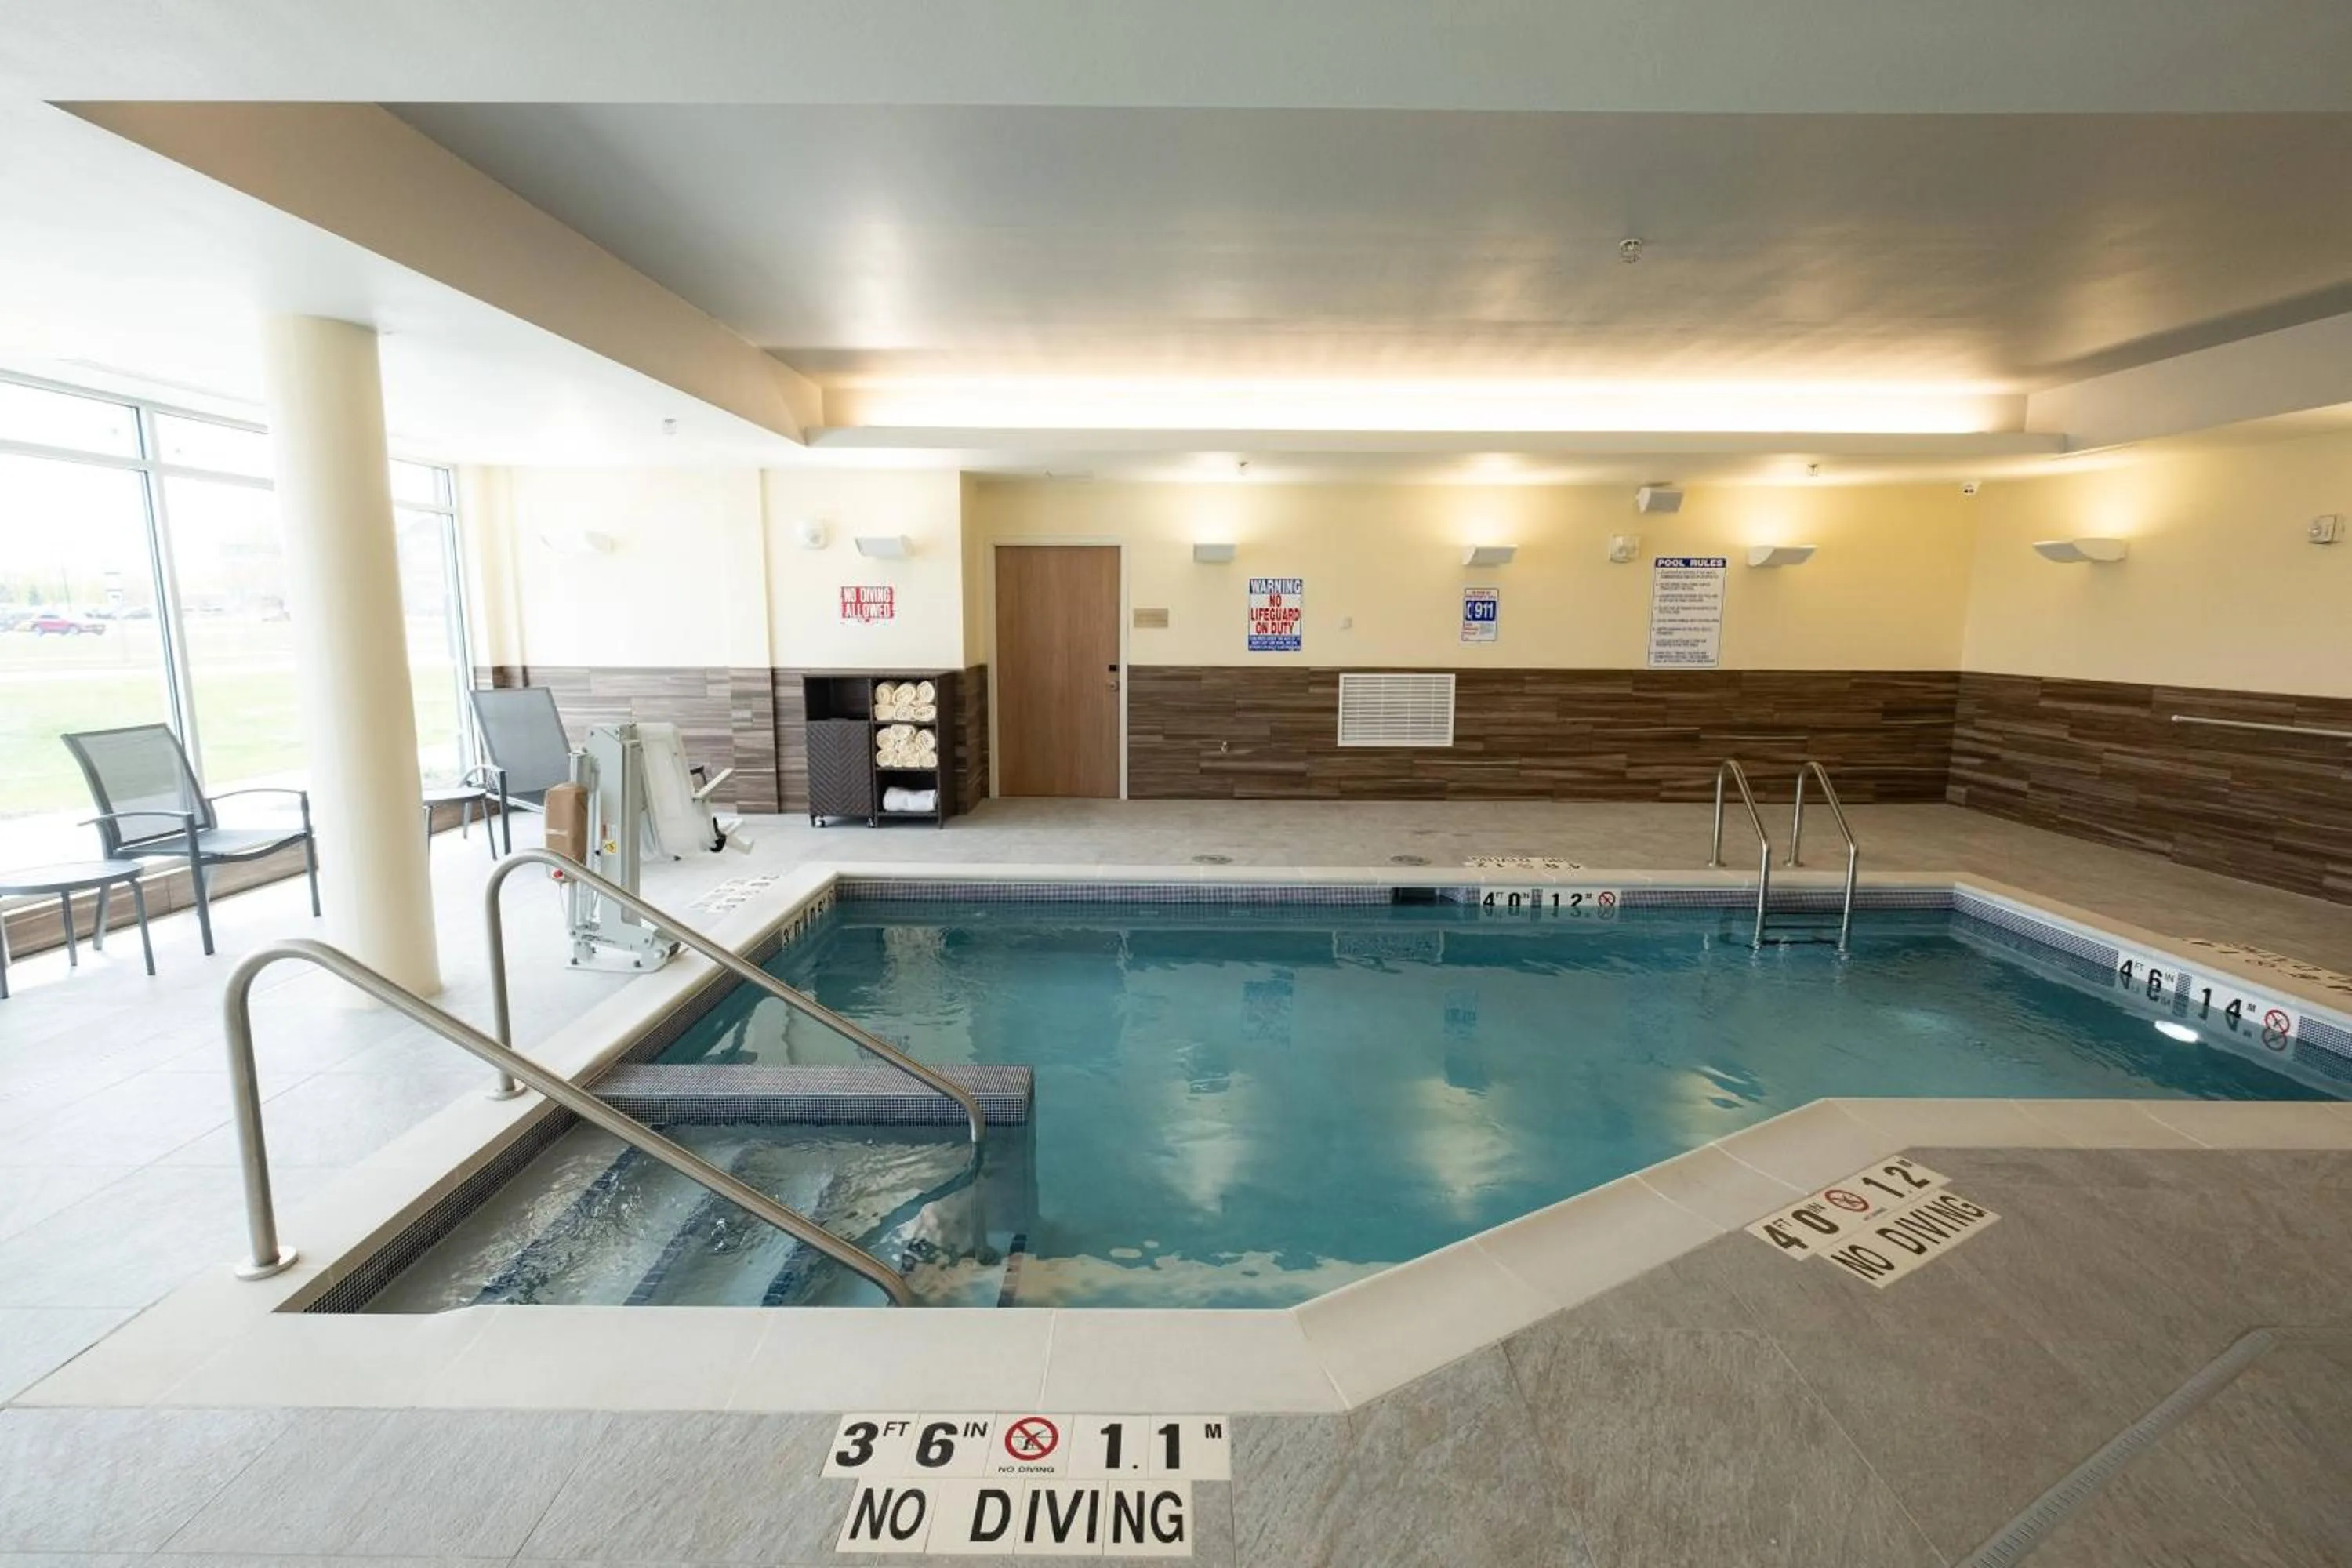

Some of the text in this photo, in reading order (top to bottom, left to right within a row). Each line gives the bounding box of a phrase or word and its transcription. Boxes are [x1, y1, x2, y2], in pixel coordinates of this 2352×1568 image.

[1250, 580, 1301, 593] WARNING
[859, 588, 891, 602] DIVING
[1269, 594, 1282, 607] NO
[845, 603, 890, 617] ALLOWED
[1250, 608, 1301, 621] LIFEGUARD
[1475, 601, 1494, 619] 911
[1255, 622, 1294, 633] ON DUTY
[1831, 1194, 1988, 1280] NO DIVING
[1018, 1465, 1055, 1474] DIVING
[848, 1487, 1185, 1544] NO DIVING
